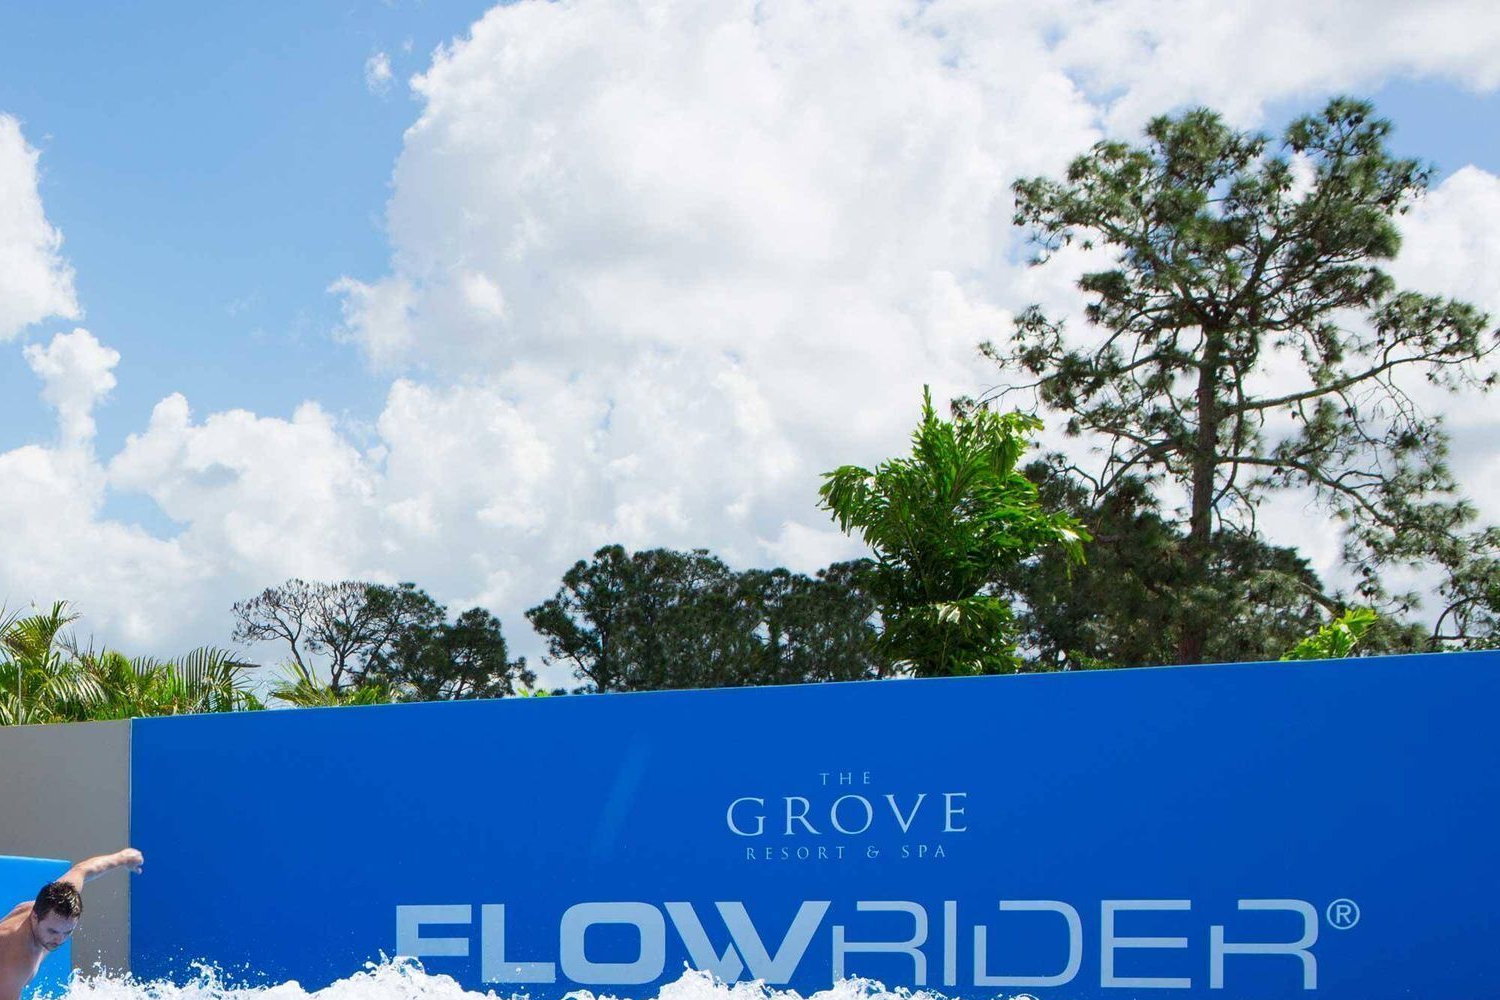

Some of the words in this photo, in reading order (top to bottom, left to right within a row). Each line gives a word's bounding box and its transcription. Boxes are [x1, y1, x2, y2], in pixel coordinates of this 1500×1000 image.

[820, 771, 871, 786] THE
[726, 792, 968, 837] GROVE
[746, 846, 846, 860] RESORT
[866, 845, 880, 859] &
[902, 844, 946, 859] SPA
